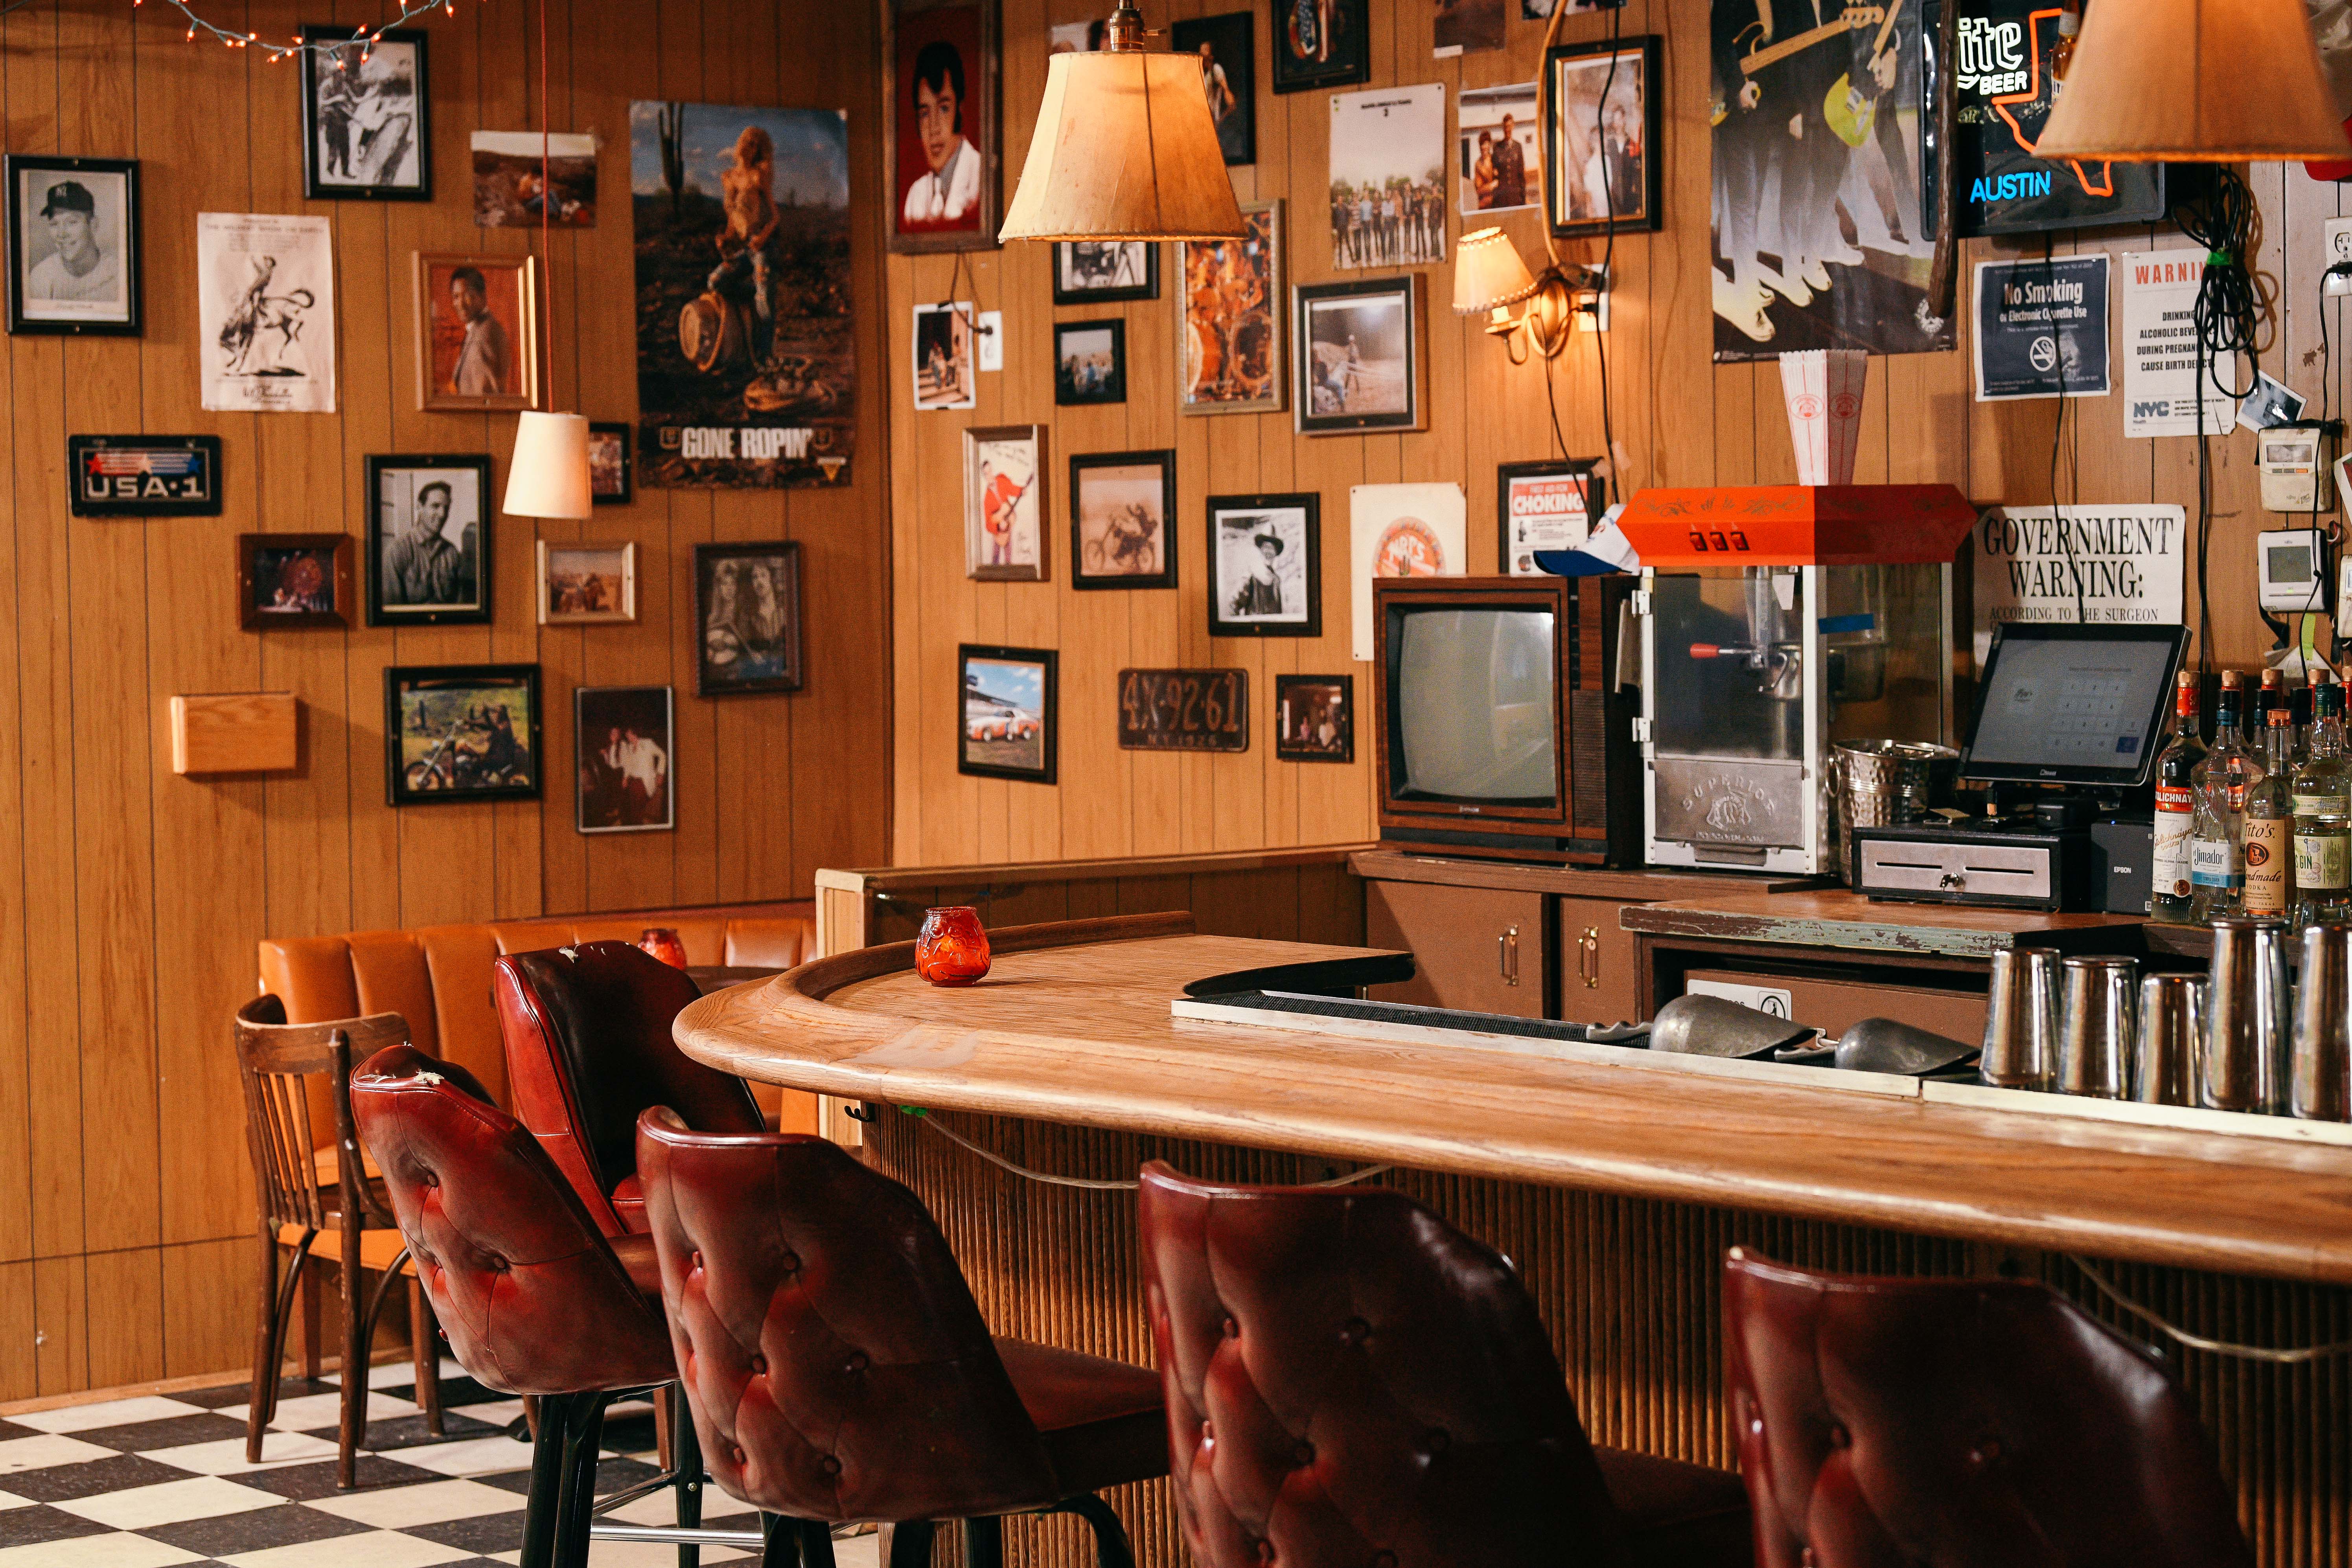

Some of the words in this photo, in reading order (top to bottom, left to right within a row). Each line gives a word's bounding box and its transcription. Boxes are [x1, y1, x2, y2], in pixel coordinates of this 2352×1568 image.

[1958, 17, 2023, 74] ite
[1980, 71, 2028, 95] BEER
[1970, 171, 2051, 204] AUSTIN
[2135, 261, 2207, 284] WARNIN
[2004, 283, 2022, 305] No
[2025, 278, 2083, 305] Smoking
[2140, 328, 2177, 339] ALCOHOLIC
[2137, 345, 2163, 355] DURING
[2165, 343, 2196, 354] PREGNAN
[2141, 361, 2163, 372] CAUSE
[2165, 359, 2185, 370] BIRTH
[2133, 401, 2169, 418] NYC
[681, 427, 735, 459] GONE
[1514, 493, 1584, 513] CHOKING
[1984, 517, 2173, 555] GOVERNMENT
[2008, 560, 2143, 598] WARNING:
[1991, 607, 2052, 620] ACCORDING
[2057, 608, 2072, 620] TO
[2105, 608, 2159, 621] SURGEON
[2194, 847, 2224, 865] Jimador
[2300, 855, 2312, 870] GIN
